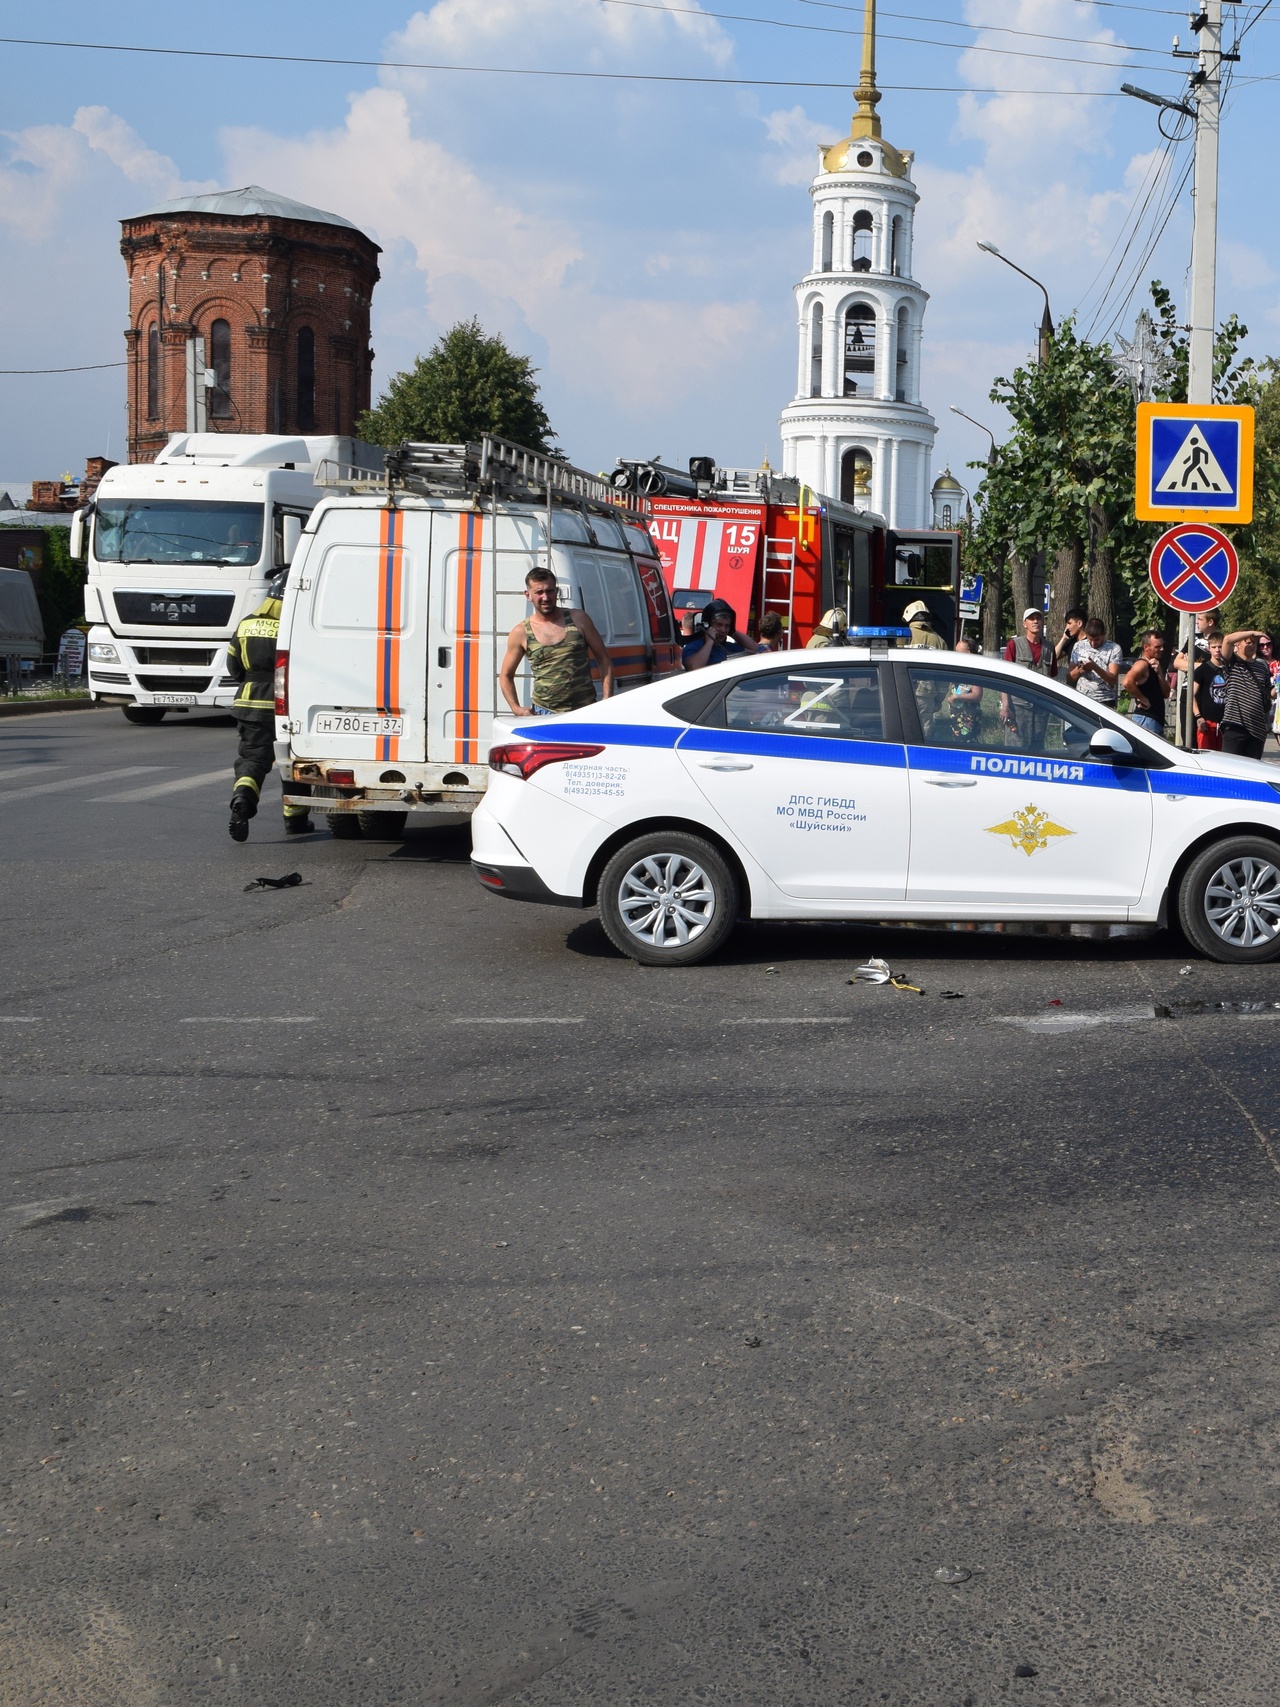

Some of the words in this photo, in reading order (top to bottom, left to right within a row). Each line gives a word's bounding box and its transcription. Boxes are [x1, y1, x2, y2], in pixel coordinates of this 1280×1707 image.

[654, 504, 702, 512] СПЕЦТЕХНИКА
[703, 507, 761, 515] ПОЖАРОТУШЕНИЯ
[649, 521, 678, 543] АЦ
[726, 525, 756, 546] 15
[727, 546, 750, 554] ШУЯ
[151, 602, 196, 613] MAN
[562, 763, 603, 771] Дежурная
[605, 765, 631, 773] часть:
[971, 756, 1084, 780] ПОЛИЦИЯ
[565, 771, 626, 780] 8(49351)3-82-26
[563, 787, 625, 796] 8(4932)35-45-55
[788, 795, 814, 805] ДПС
[817, 797, 856, 809] ГИБДД
[776, 806, 795, 816] МО
[797, 808, 823, 819] МВД
[826, 810, 867, 821] России
[789, 820, 852, 831] «Шуйский»
